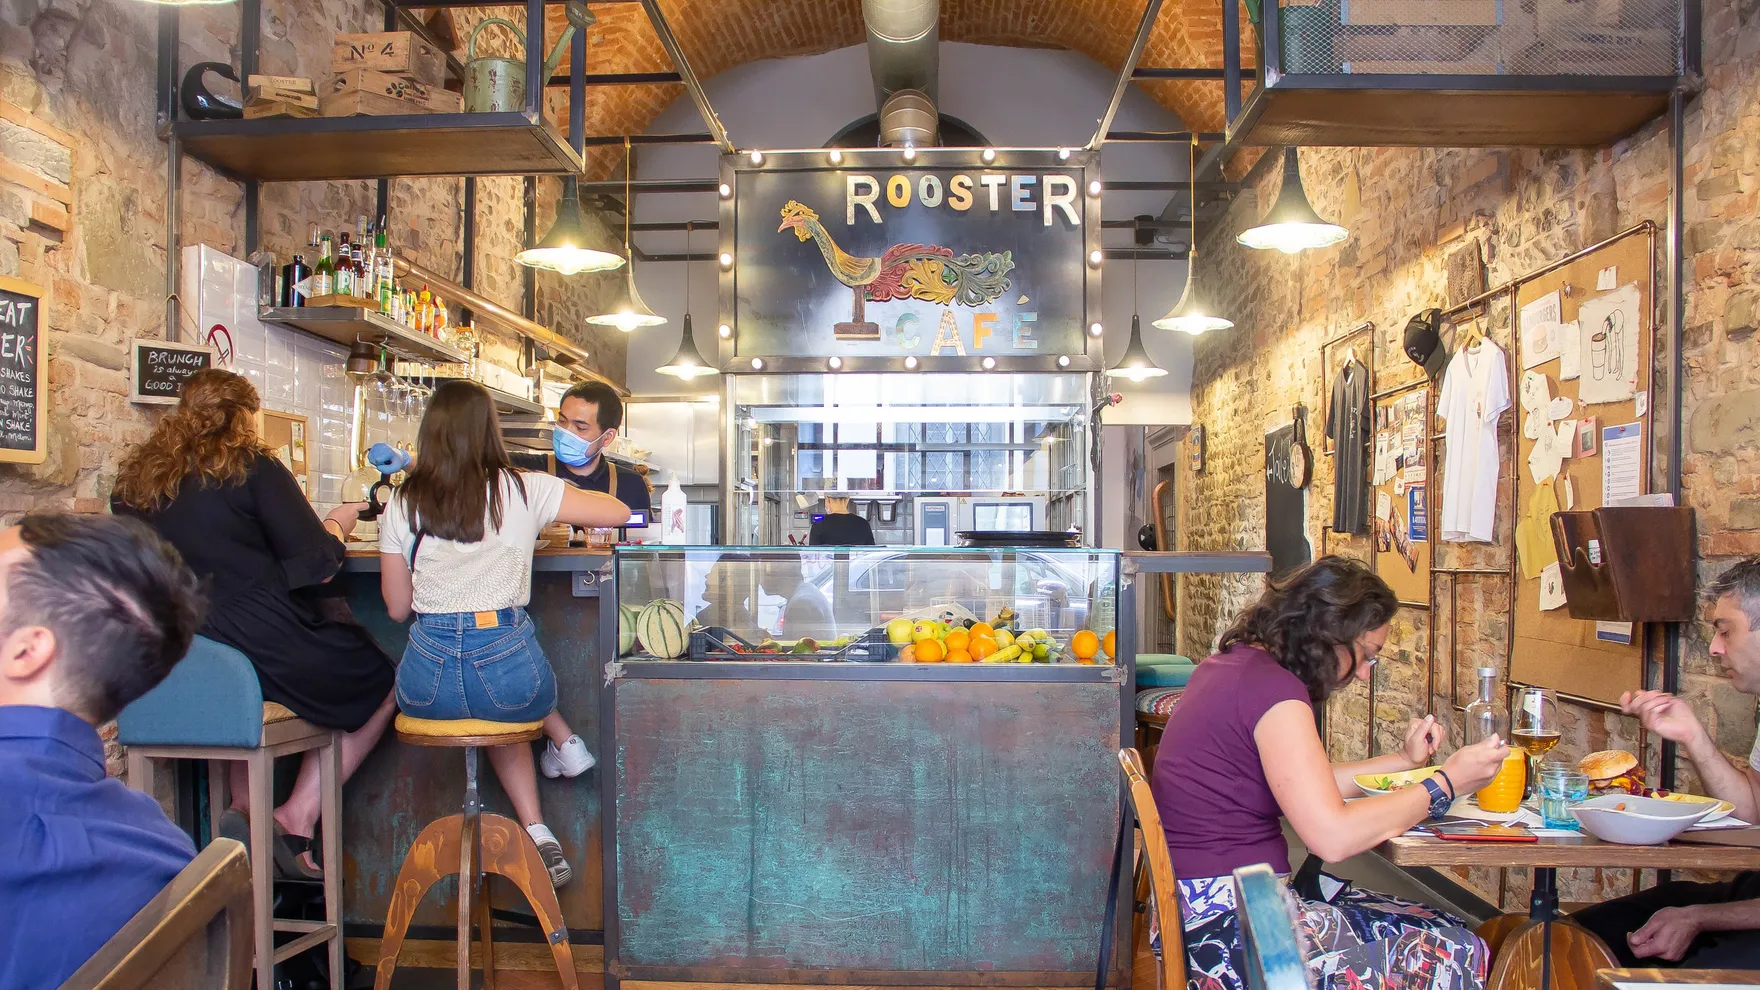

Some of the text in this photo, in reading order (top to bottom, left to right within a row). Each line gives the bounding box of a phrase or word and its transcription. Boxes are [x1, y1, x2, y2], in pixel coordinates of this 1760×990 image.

[381, 41, 394, 57] 4
[846, 174, 1080, 226] ROOSTER
[896, 295, 1038, 356] CAFÉ
[148, 351, 203, 366] BRUNCH
[0, 367, 31, 383] SHAKES
[153, 365, 164, 374] is
[9, 385, 34, 398] SHAKE
[145, 380, 173, 391] GOOD
